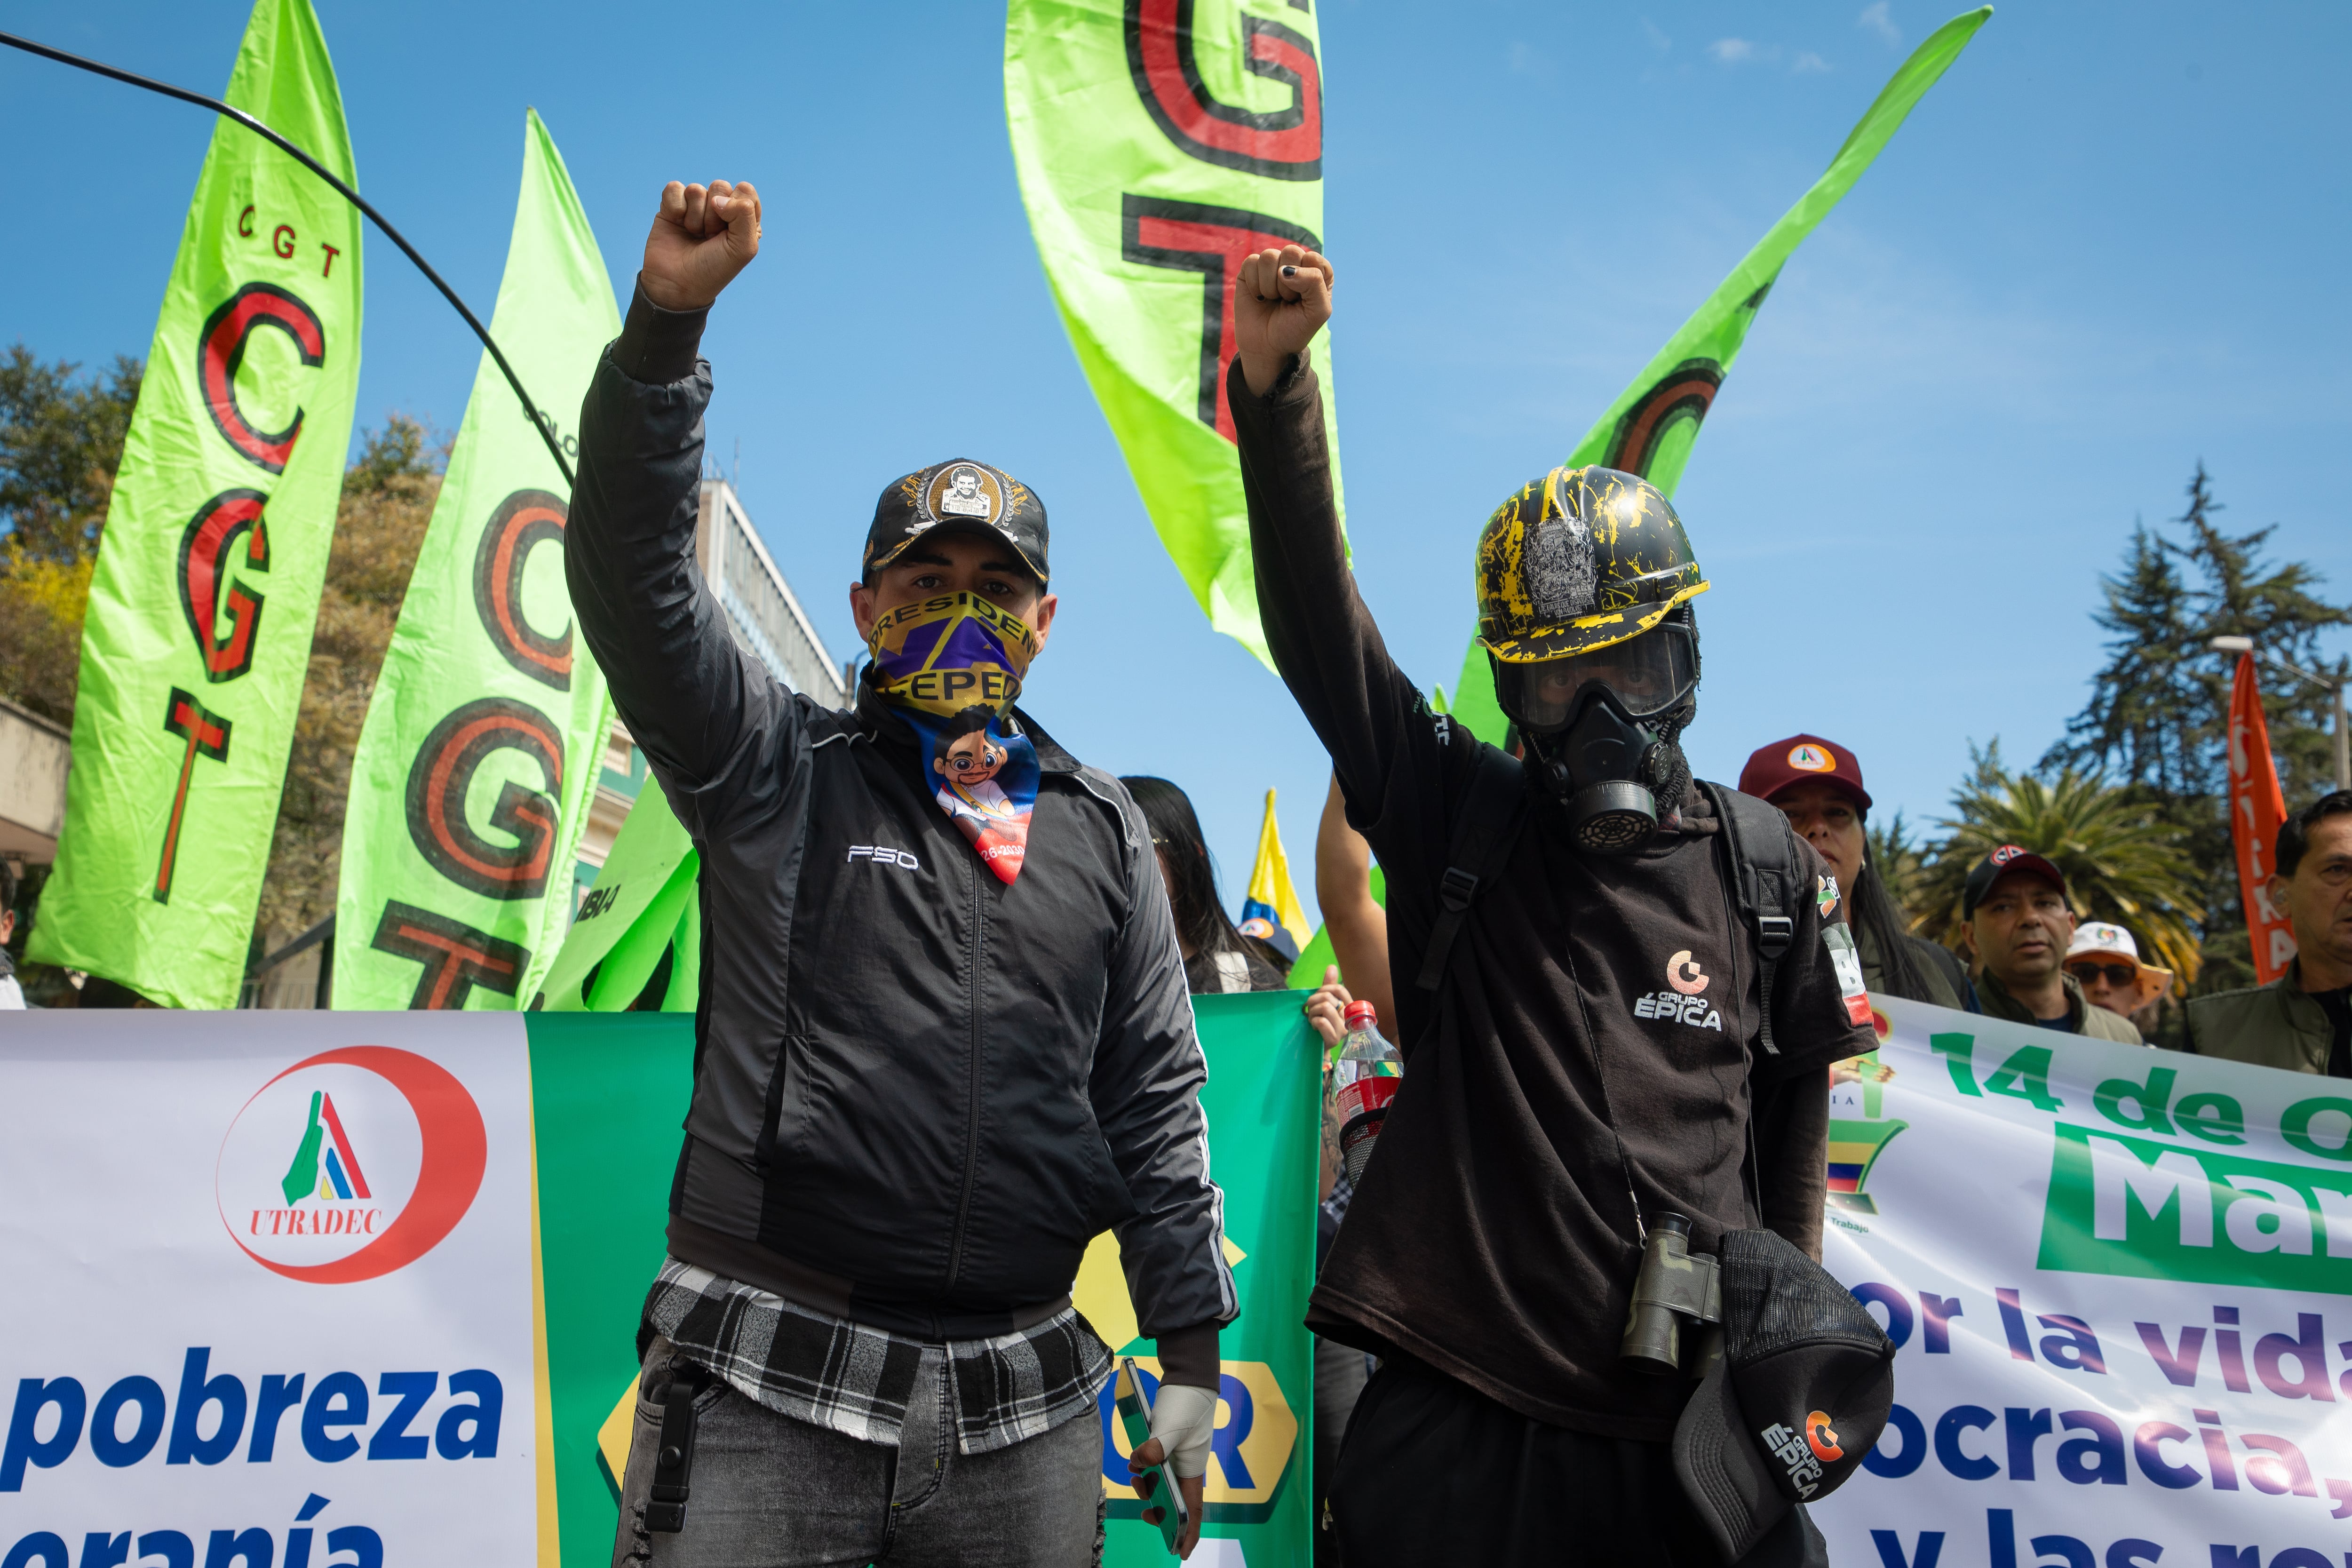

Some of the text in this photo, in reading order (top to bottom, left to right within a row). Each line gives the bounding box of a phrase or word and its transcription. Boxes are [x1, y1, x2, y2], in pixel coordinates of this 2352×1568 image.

[1634, 992, 1722, 1032] ÉPICA
[1658, 992, 1708, 1009] GRUPO
[1929, 1032, 2066, 1113] 14
[2093, 1067, 2249, 1146] de
[250, 1209, 382, 1236] UTRADEC
[1831, 1217, 1868, 1233] Trabajo
[1995, 1287, 2107, 1375] la
[2133, 1305, 2352, 1402] vid
[0, 1346, 503, 1492] pobreza
[1761, 1423, 1818, 1500] ÉPICA
[1793, 1435, 1823, 1478] GRUPO
